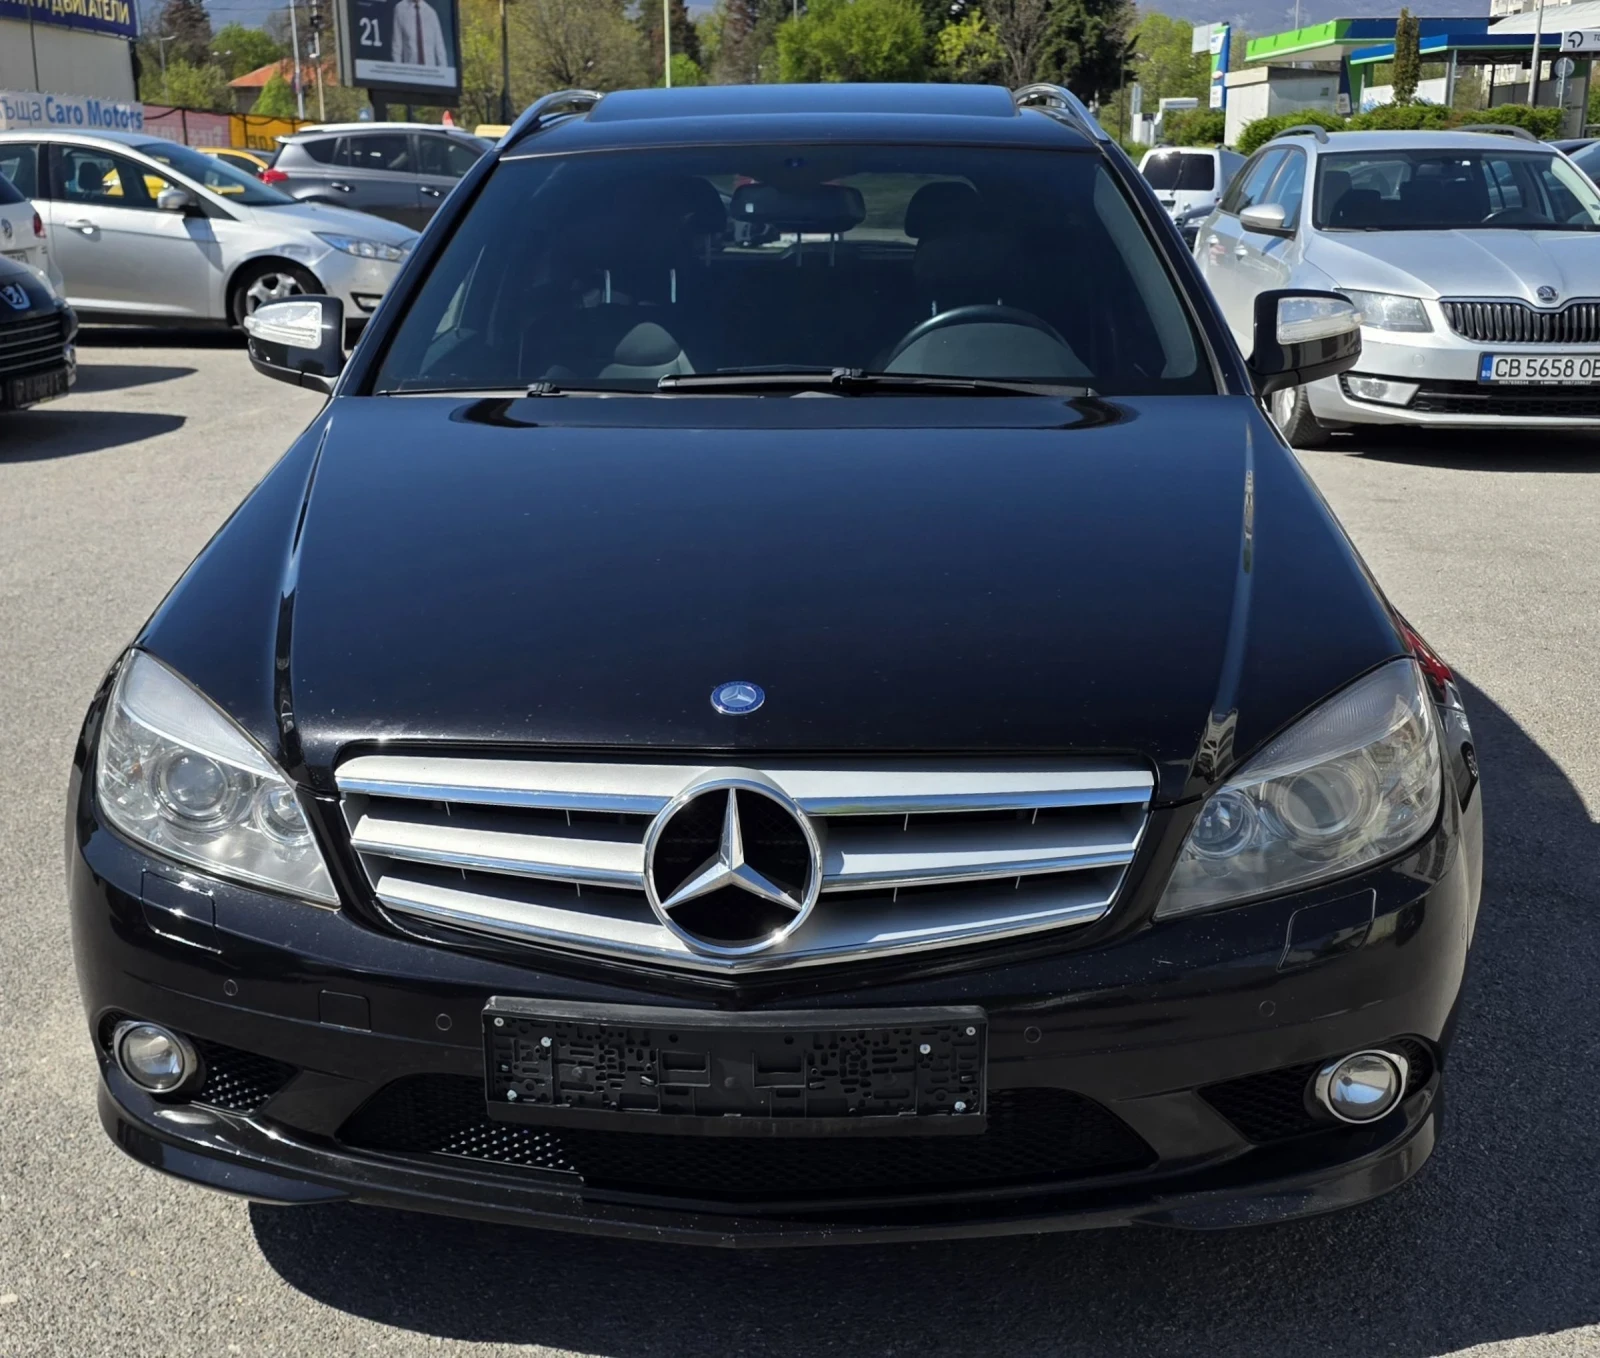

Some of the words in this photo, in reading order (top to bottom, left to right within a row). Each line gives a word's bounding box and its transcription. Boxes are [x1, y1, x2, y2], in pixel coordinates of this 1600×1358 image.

[360, 17, 382, 47] 21
[1, 98, 42, 126] ъща
[45, 96, 84, 125] Caro
[86, 100, 143, 129] Motors
[1495, 359, 1521, 378] CB
[1526, 359, 1574, 378] 5658
